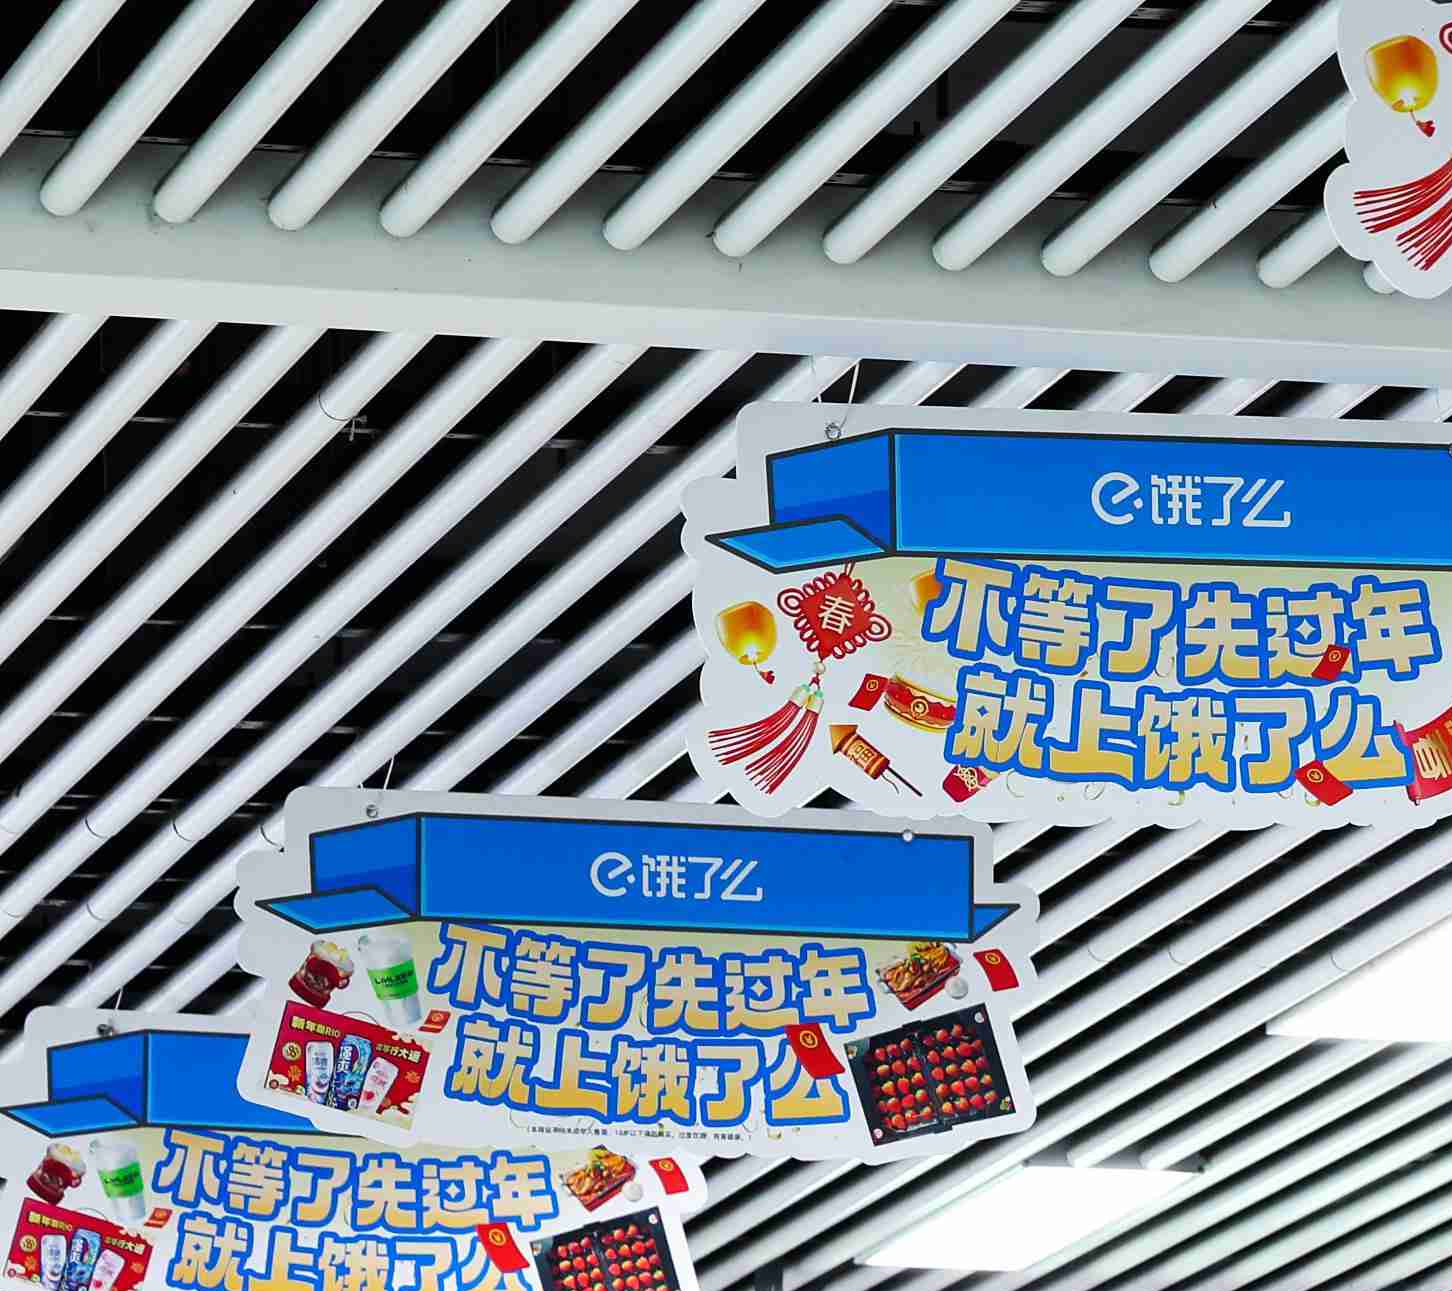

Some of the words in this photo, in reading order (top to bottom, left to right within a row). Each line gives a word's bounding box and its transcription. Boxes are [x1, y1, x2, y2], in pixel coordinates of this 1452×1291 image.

[817, 594, 855, 634] 春
[922, 557, 1441, 689] 不等了先过年
[945, 665, 1412, 792] 就上饿了么
[429, 923, 876, 1036] 不等了先过年
[445, 1011, 849, 1126] 就上饿了么
[153, 1129, 558, 1231] 不等了先过年
